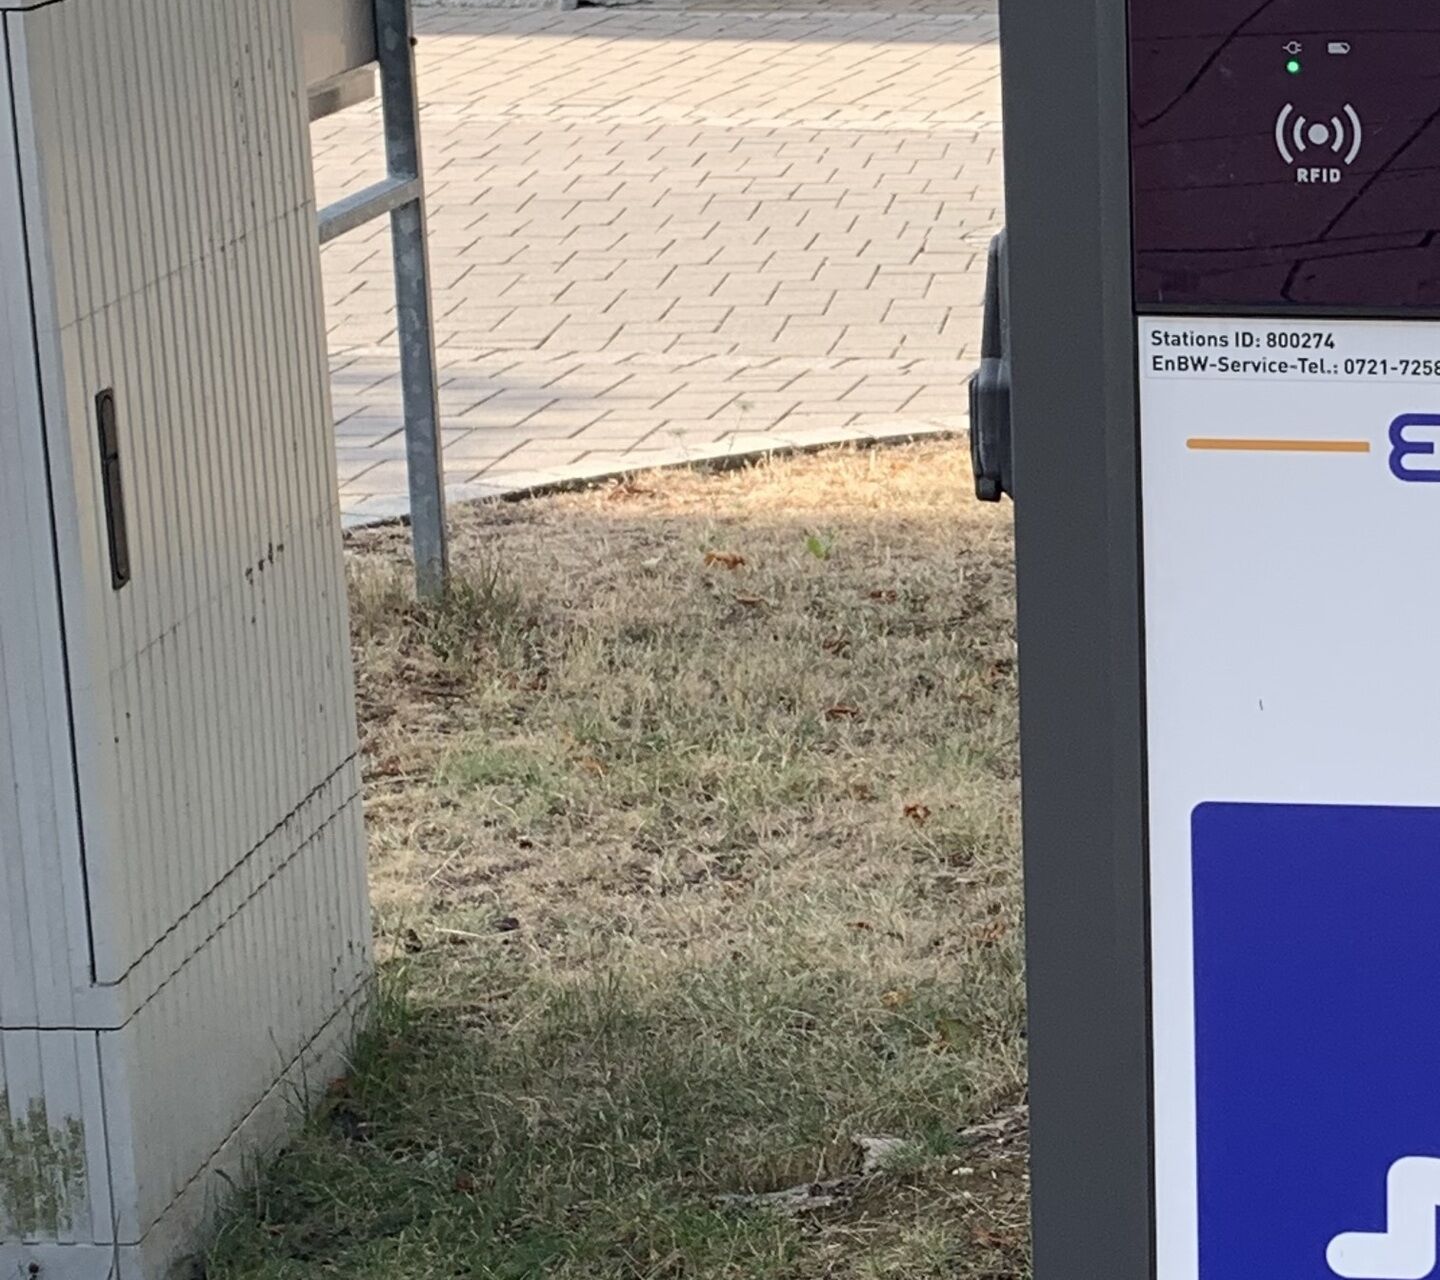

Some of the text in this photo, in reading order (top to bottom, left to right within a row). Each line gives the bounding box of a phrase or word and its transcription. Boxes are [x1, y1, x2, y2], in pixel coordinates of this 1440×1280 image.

[1296, 168, 1341, 183] RFID
[1151, 330, 1336, 350] Stations ID: 800274
[1152, 355, 1338, 375] EnBW-Service-Tel.:
